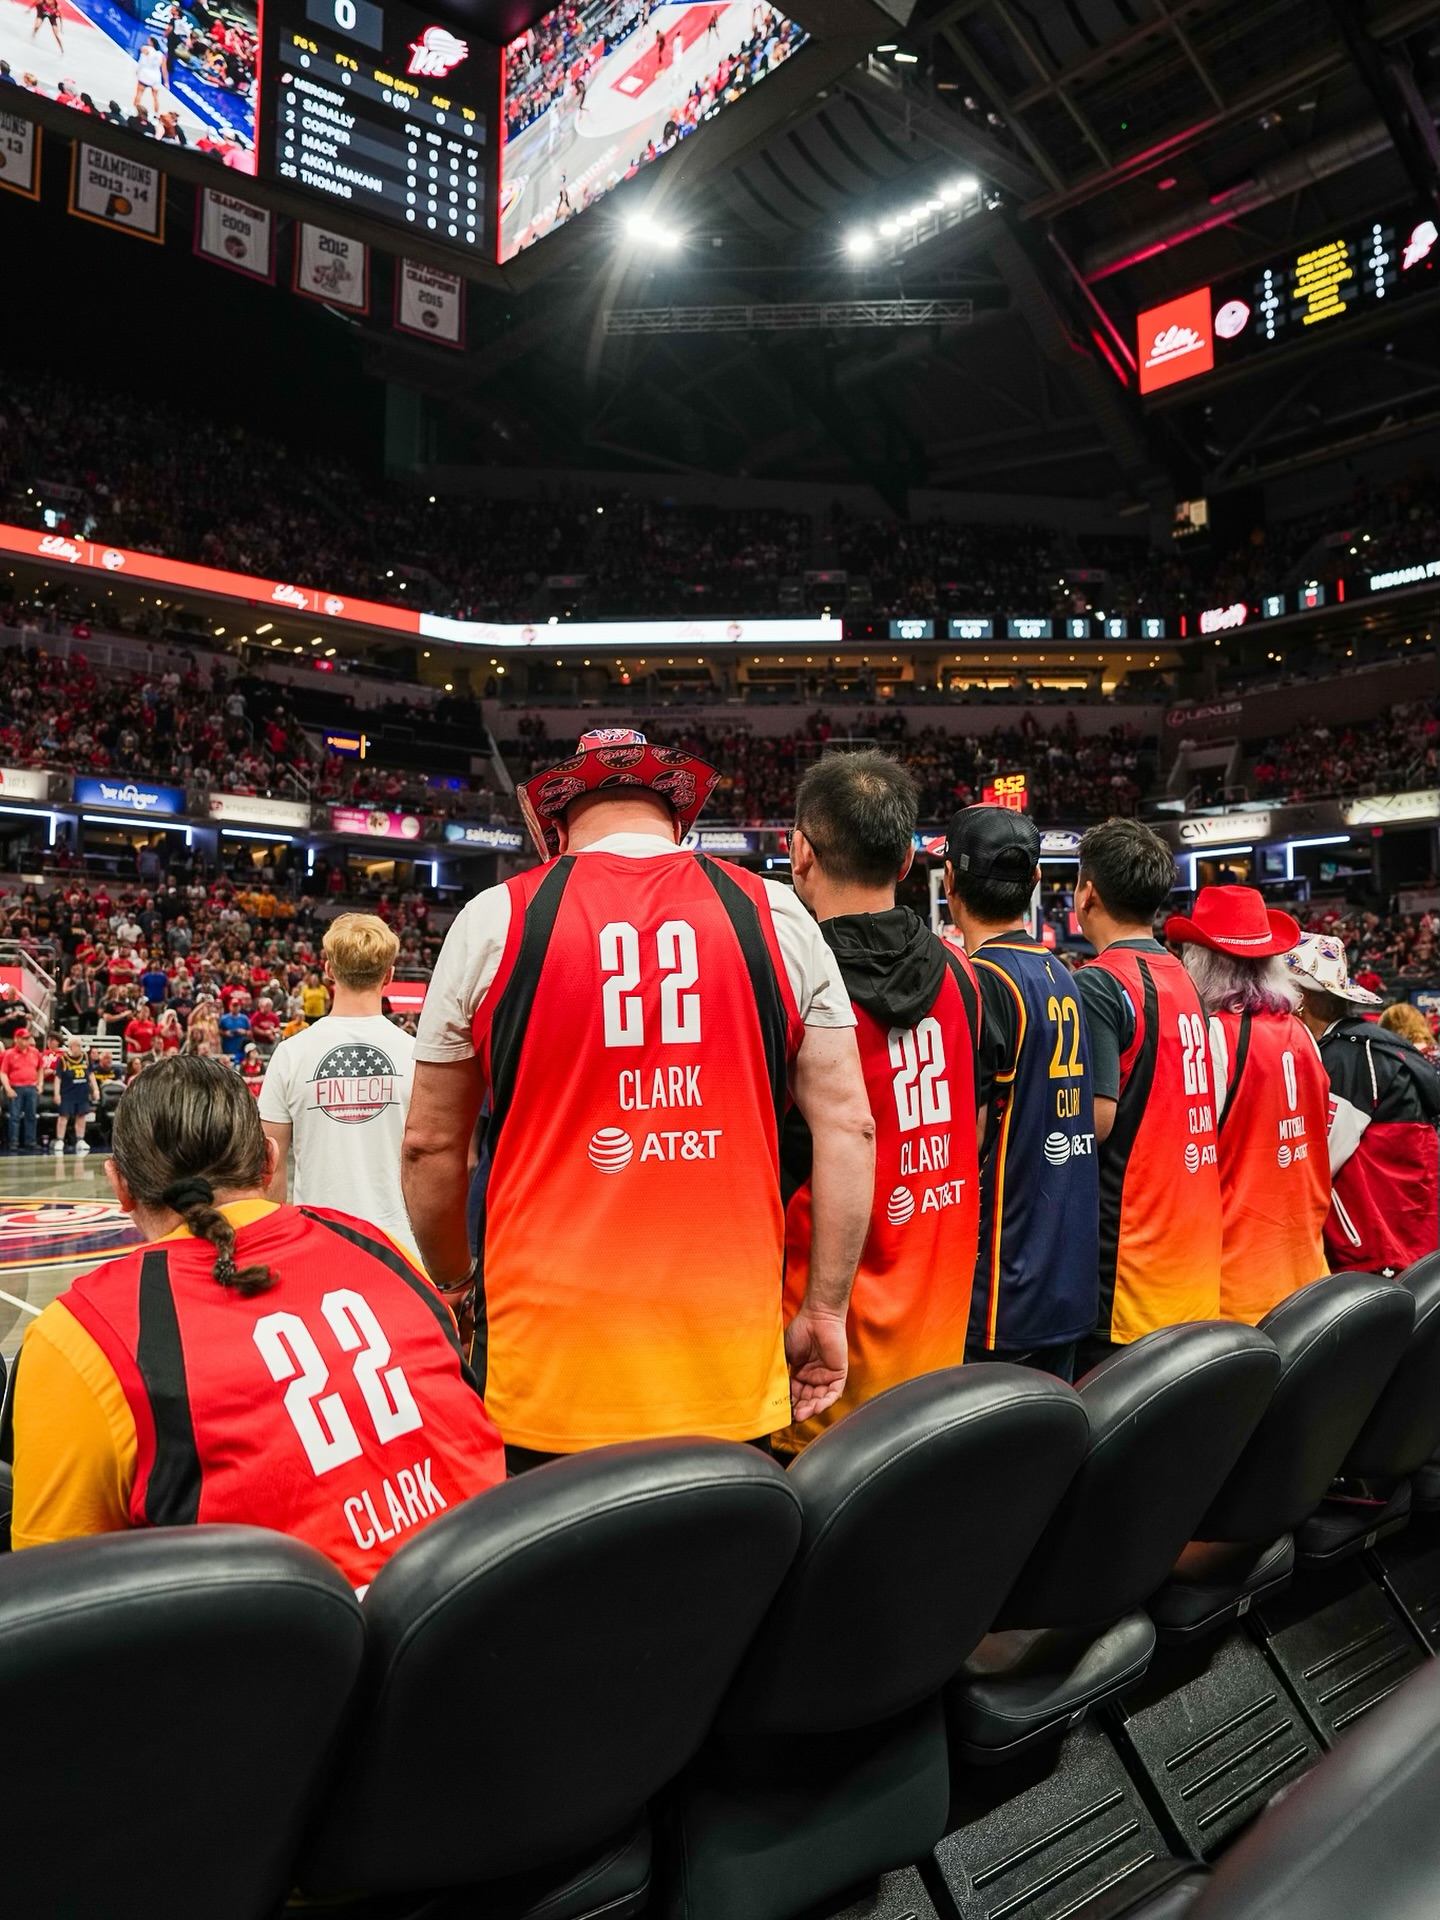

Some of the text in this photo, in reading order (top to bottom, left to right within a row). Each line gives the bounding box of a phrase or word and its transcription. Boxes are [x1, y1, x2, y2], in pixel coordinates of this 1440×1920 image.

[335, 0, 357, 29] 0
[294, 77, 345, 107] MERCURY
[285, 110, 296, 124] 2
[302, 116, 350, 145] COPPER
[287, 91, 296, 105] 0
[303, 98, 356, 129] SABALLY
[285, 128, 295, 141] 4
[301, 133, 338, 158] MACK
[87, 148, 153, 186] CHAMPIONS
[280, 162, 297, 178] 25
[300, 169, 352, 199] THOMAS
[300, 151, 335, 175] AKOA
[335, 164, 383, 193] MAKANI
[89, 172, 123, 194] 2013
[133, 190, 149, 203] 14
[318, 234, 350, 260] 2012
[1370, 564, 1427, 591] INDIANA
[1186, 702, 1243, 720] LEXUS
[118, 784, 159, 810] Kroger
[994, 774, 1026, 796] 9:52
[466, 827, 523, 847] salesforce
[599, 919, 702, 1048] 22
[1048, 995, 1084, 1079] 22
[1178, 1013, 1208, 1096] 22
[315, 1077, 394, 1105] FINTECH
[619, 1065, 703, 1112] CLARK
[887, 1016, 952, 1133] 22
[1281, 1051, 1298, 1112] 0
[639, 1129, 723, 1163] AT&T
[900, 1133, 951, 1177] CLARK
[1070, 1133, 1095, 1156] &T
[921, 1179, 966, 1214] AT&T
[252, 1288, 424, 1477] 22
[343, 1457, 448, 1550] CLARK
